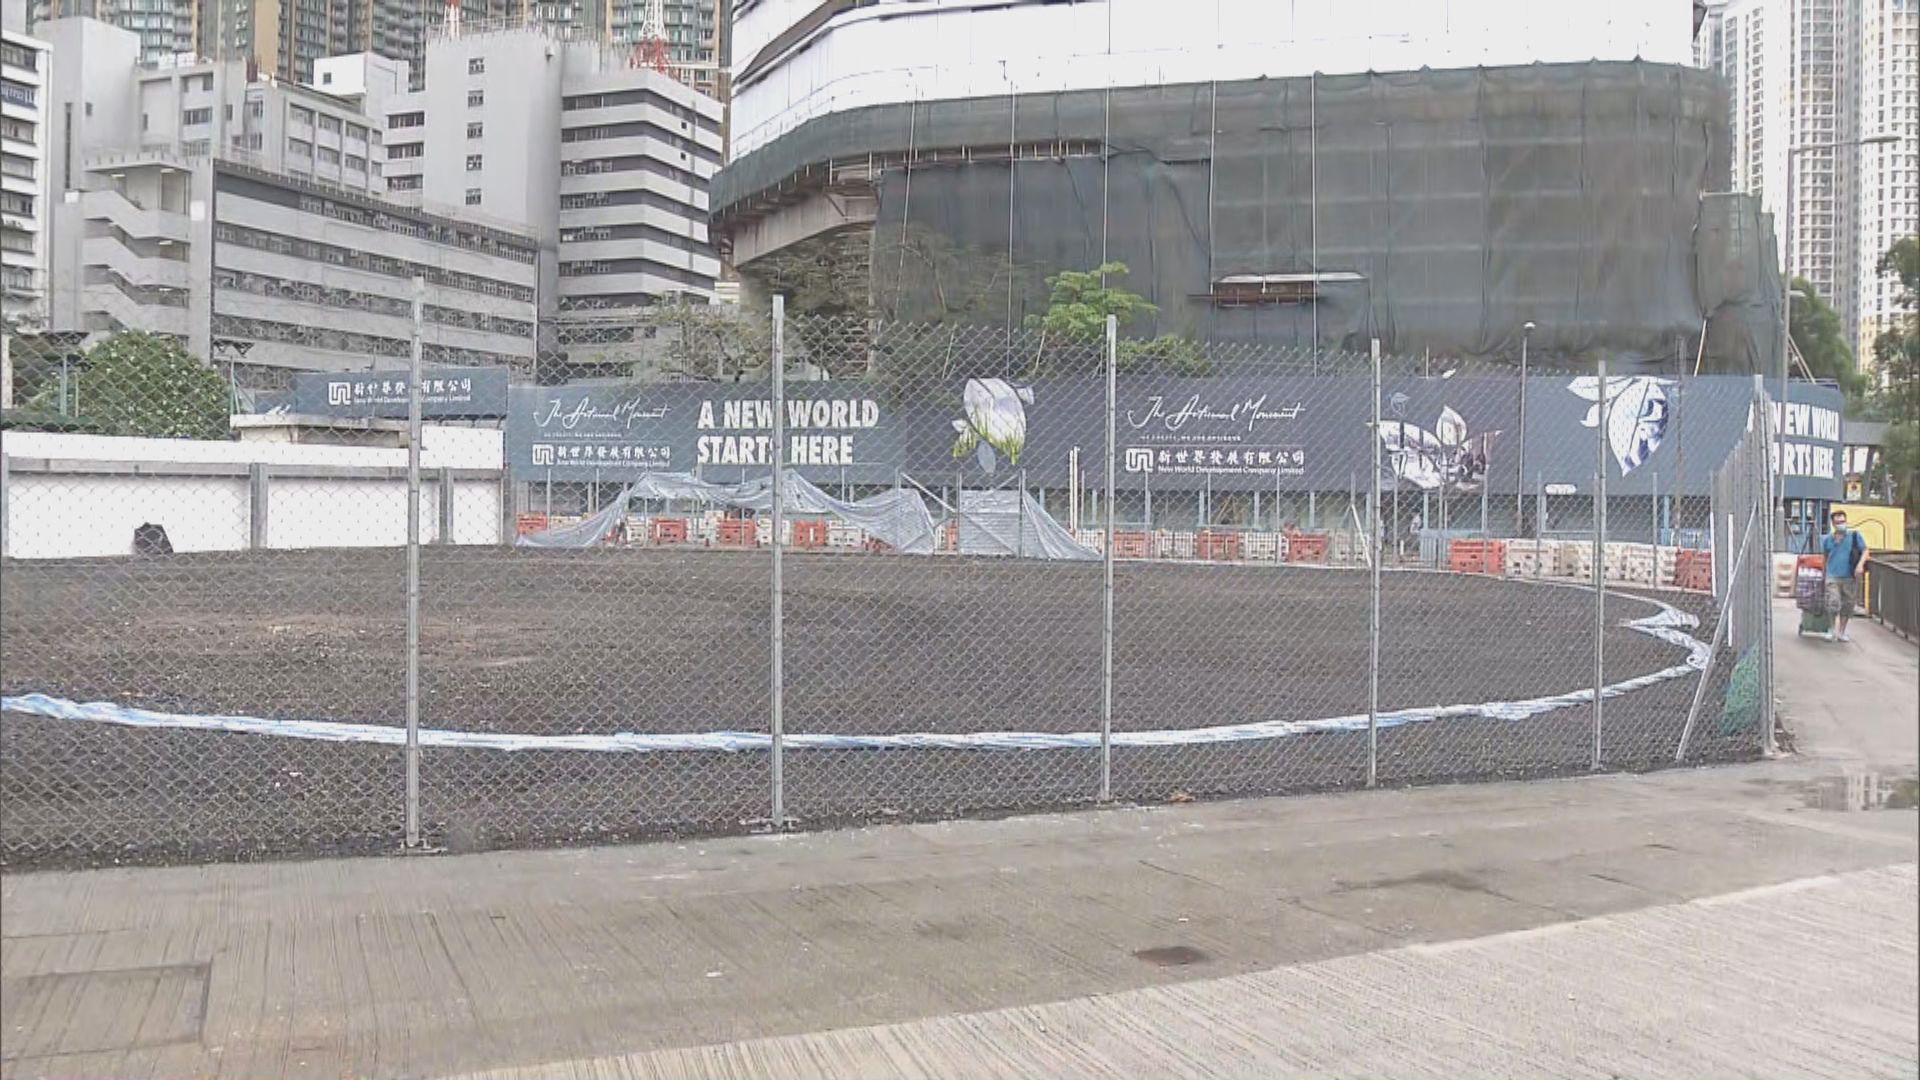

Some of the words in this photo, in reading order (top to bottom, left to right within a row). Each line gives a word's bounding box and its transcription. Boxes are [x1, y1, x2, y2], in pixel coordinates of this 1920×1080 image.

[353, 377, 471, 395] 新世界發有限公司
[533, 398, 563, 428] The
[697, 399, 715, 429] A
[724, 399, 773, 429] NEW
[787, 399, 880, 428] WORLD
[1127, 395, 1165, 429] The
[557, 445, 671, 459] 新世界發展有限公司
[791, 435, 853, 465] HERE
[1158, 449, 1305, 466] 新世界發展有限公司
[1772, 442, 1812, 476] ARTS
[1158, 465, 1173, 474] New
[1174, 465, 1195, 474] World
